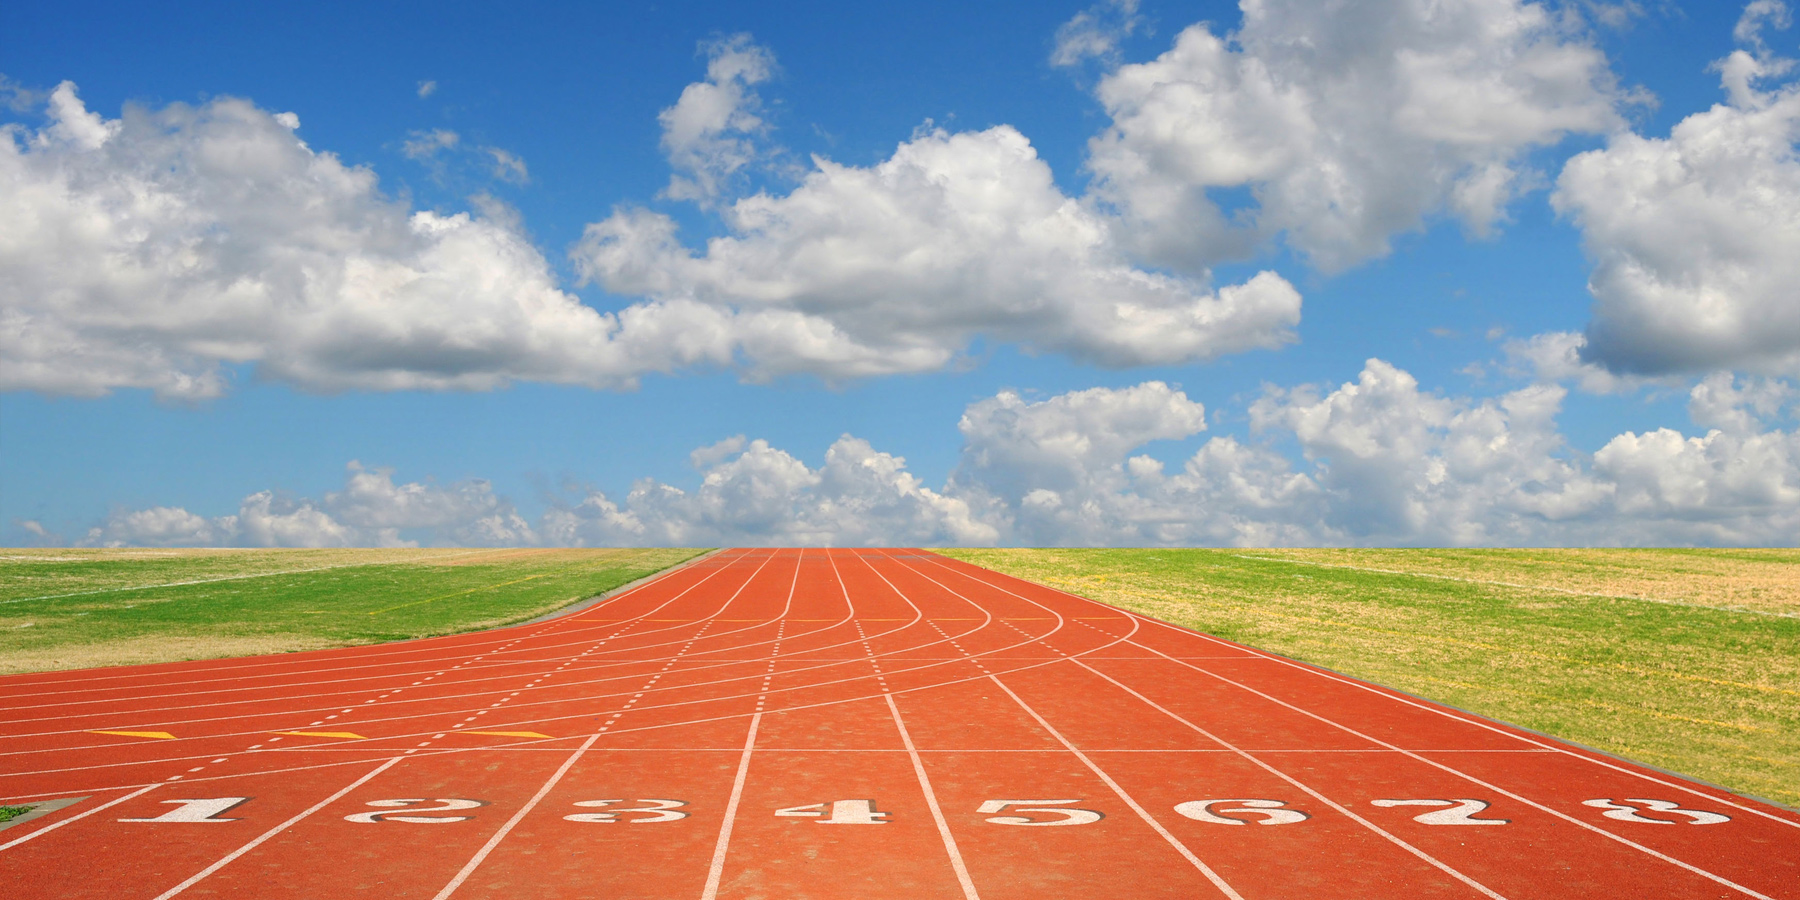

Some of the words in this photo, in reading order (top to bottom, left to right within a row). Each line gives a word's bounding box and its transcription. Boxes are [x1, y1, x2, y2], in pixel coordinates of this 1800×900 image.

[118, 797, 246, 823] 1
[344, 799, 484, 824] 2
[563, 799, 688, 824] 3
[775, 800, 890, 825] 4
[976, 800, 1102, 826] 5
[1174, 799, 1309, 826] 6
[1372, 799, 1509, 826] 7
[1583, 799, 1731, 826] 8
